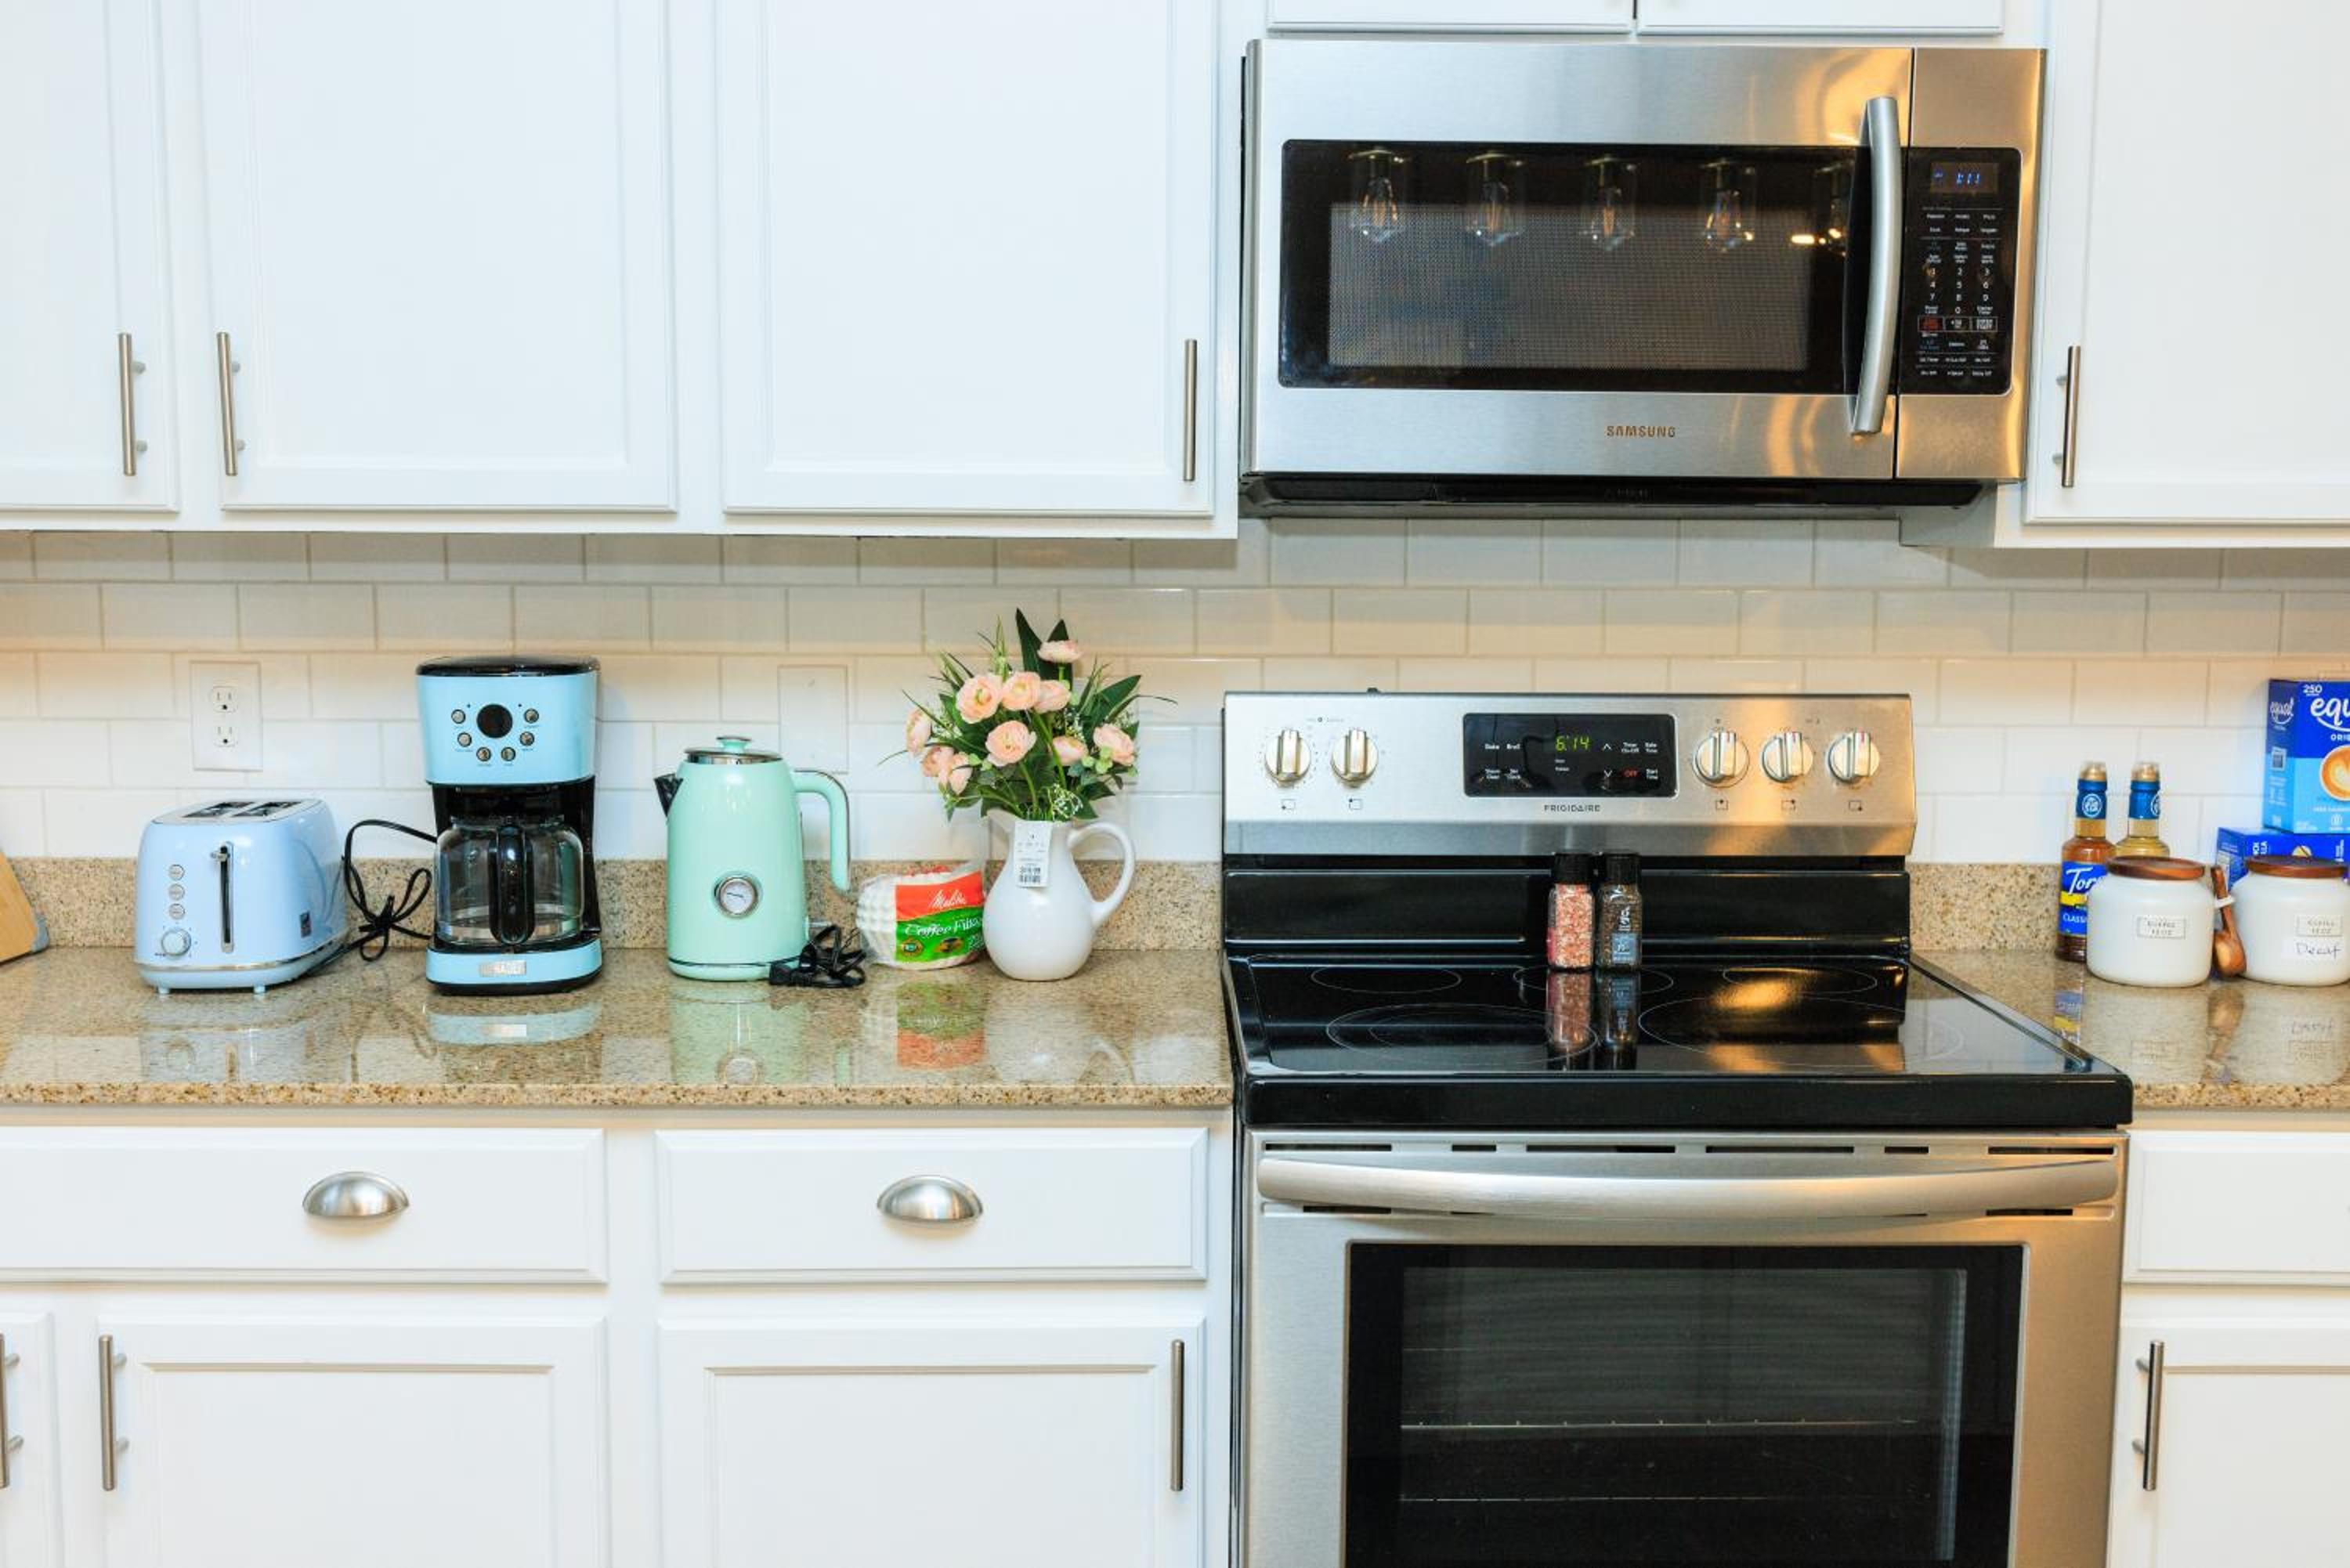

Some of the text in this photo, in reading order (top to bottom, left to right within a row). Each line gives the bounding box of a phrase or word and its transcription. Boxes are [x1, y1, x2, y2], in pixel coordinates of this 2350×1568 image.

[1606, 425, 1676, 438] SAMSUNG
[2303, 684, 2323, 694] 250
[905, 923, 952, 938] Coffee
